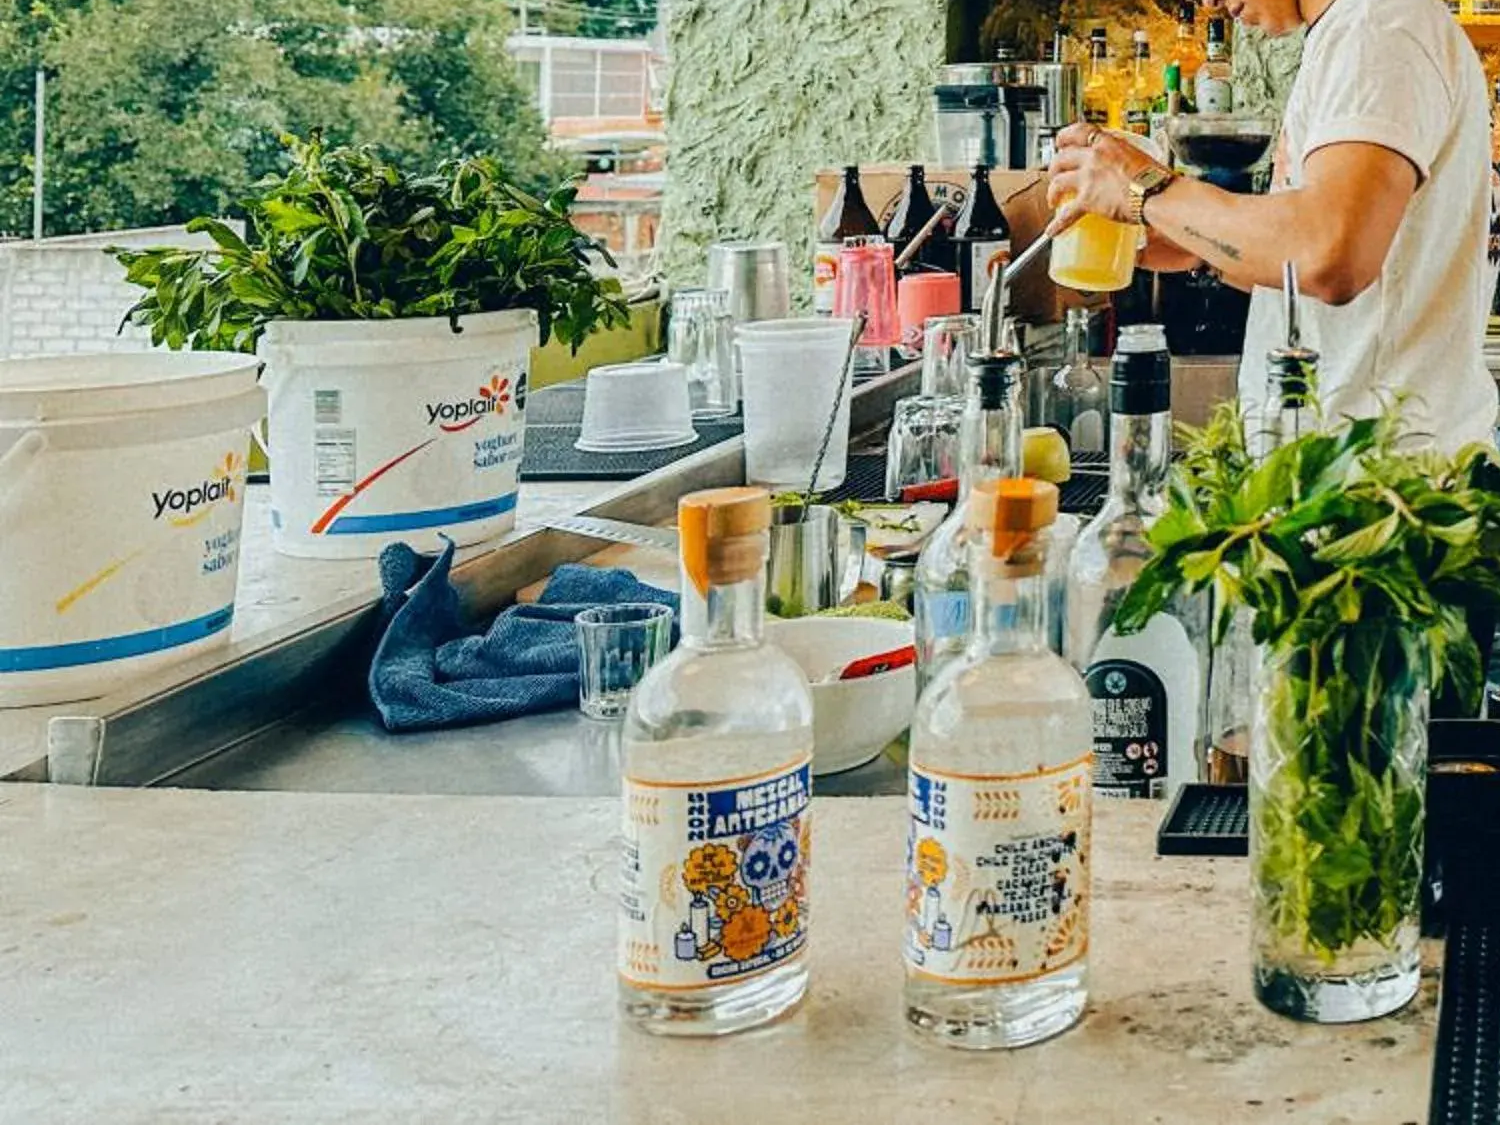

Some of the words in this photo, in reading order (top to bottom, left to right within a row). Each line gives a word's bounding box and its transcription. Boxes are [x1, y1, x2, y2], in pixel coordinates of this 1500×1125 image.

[735, 771, 805, 811] MEZCAL
[687, 792, 705, 841] 2025
[994, 841, 1028, 854] CHILE
[975, 855, 1009, 867] CHILE
[1011, 861, 1049, 877] CACAO
[975, 900, 1031, 914] ANZANA
